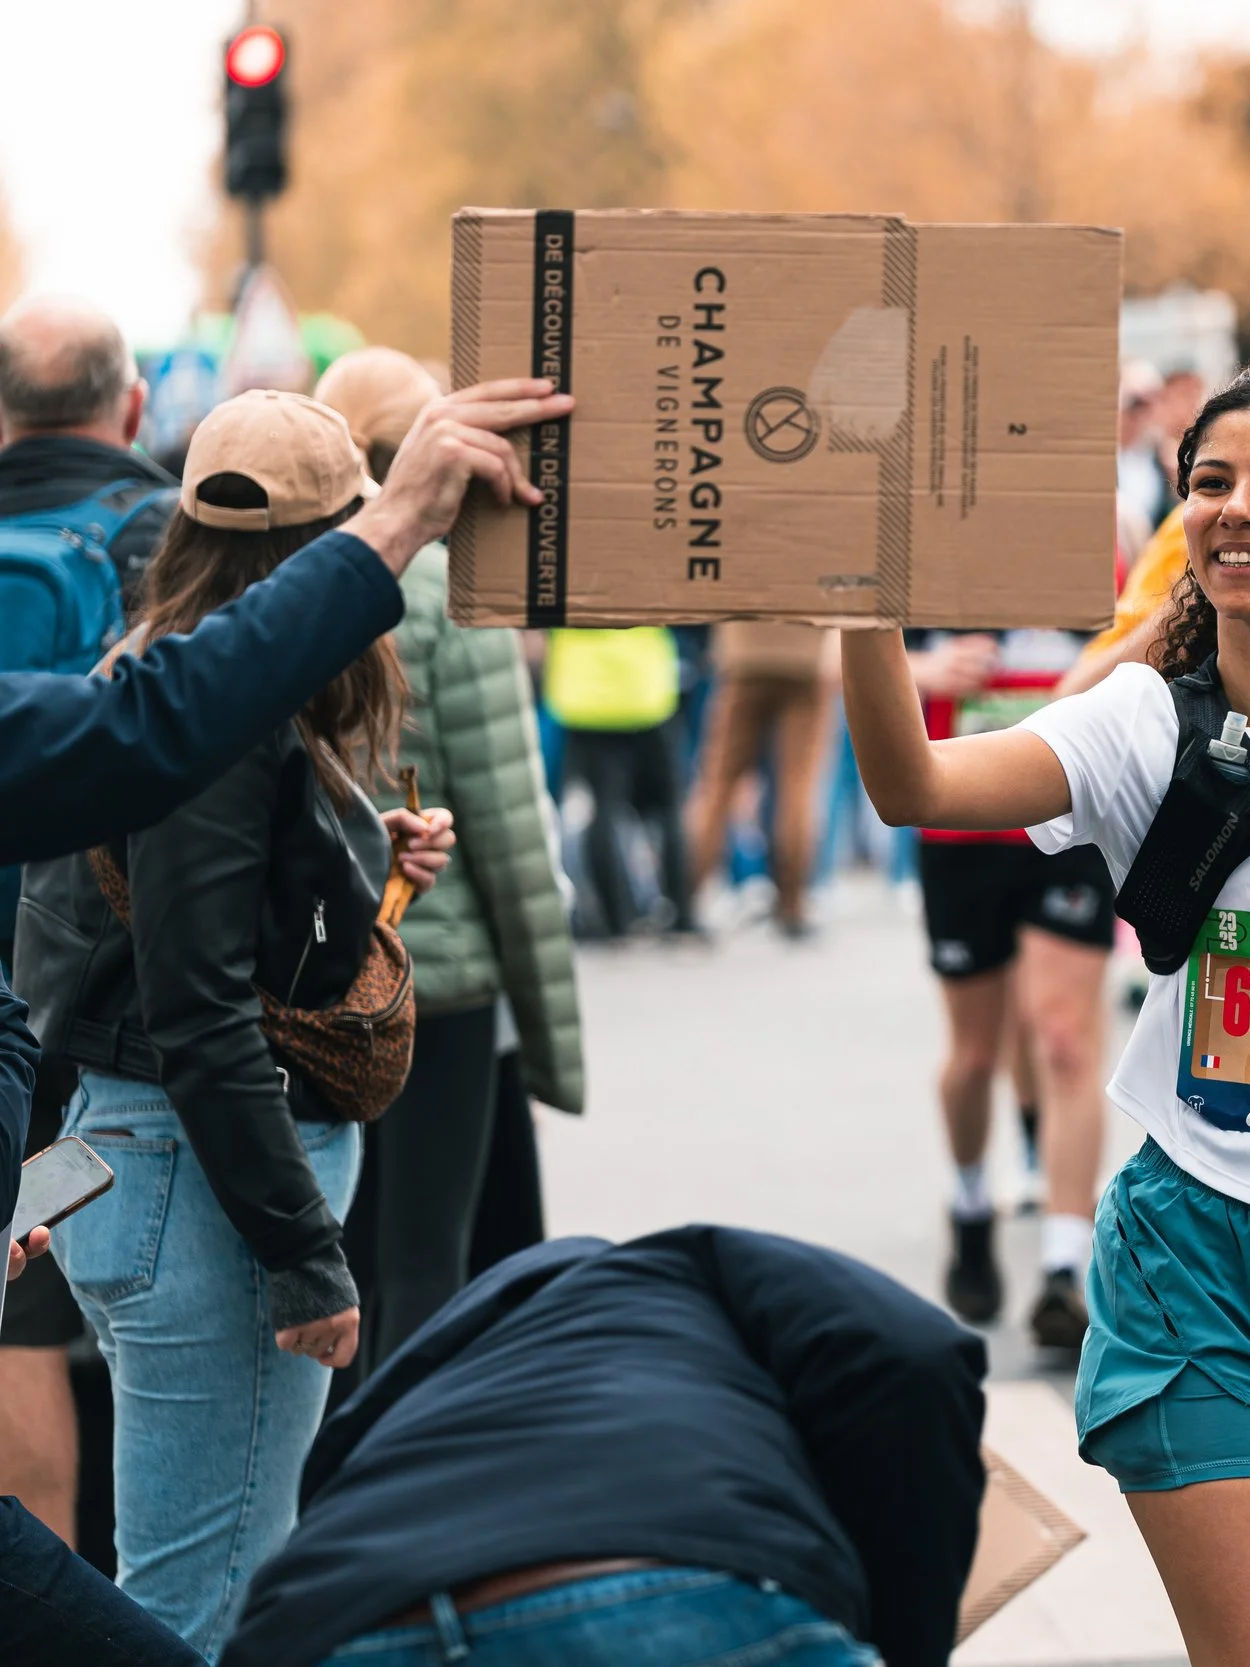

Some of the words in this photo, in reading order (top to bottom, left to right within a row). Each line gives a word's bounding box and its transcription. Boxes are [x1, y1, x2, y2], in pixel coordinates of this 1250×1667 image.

[545, 234, 564, 262] DE
[656, 315, 681, 347] DE
[541, 424, 560, 452] EN
[687, 266, 727, 582] CHAMPAGNE
[1008, 422, 1028, 437] 2
[653, 365, 680, 530] VIGNERONS
[537, 459, 563, 607] DÉCOUVERTE
[1189, 811, 1240, 892] SALOMON
[1218, 911, 1237, 932] 20
[1219, 930, 1238, 951] 25
